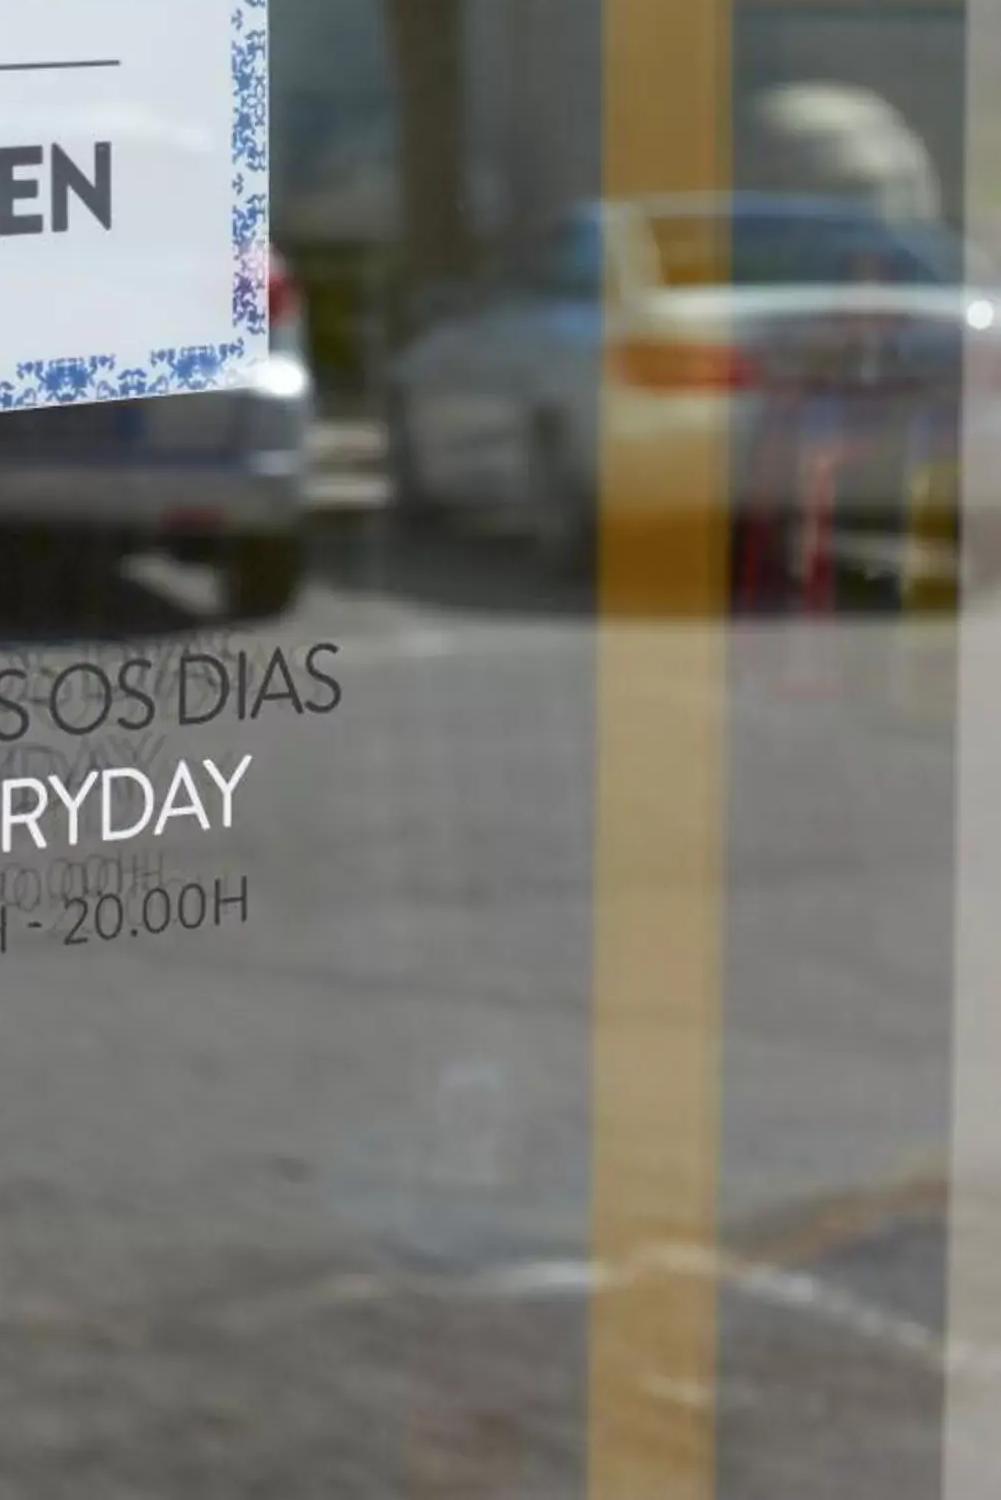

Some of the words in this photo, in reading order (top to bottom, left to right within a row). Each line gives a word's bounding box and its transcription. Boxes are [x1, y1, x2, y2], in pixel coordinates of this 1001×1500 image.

[50, 658, 155, 736] OS
[178, 642, 341, 726] DIAS
[64, 875, 247, 946] 20.00H
